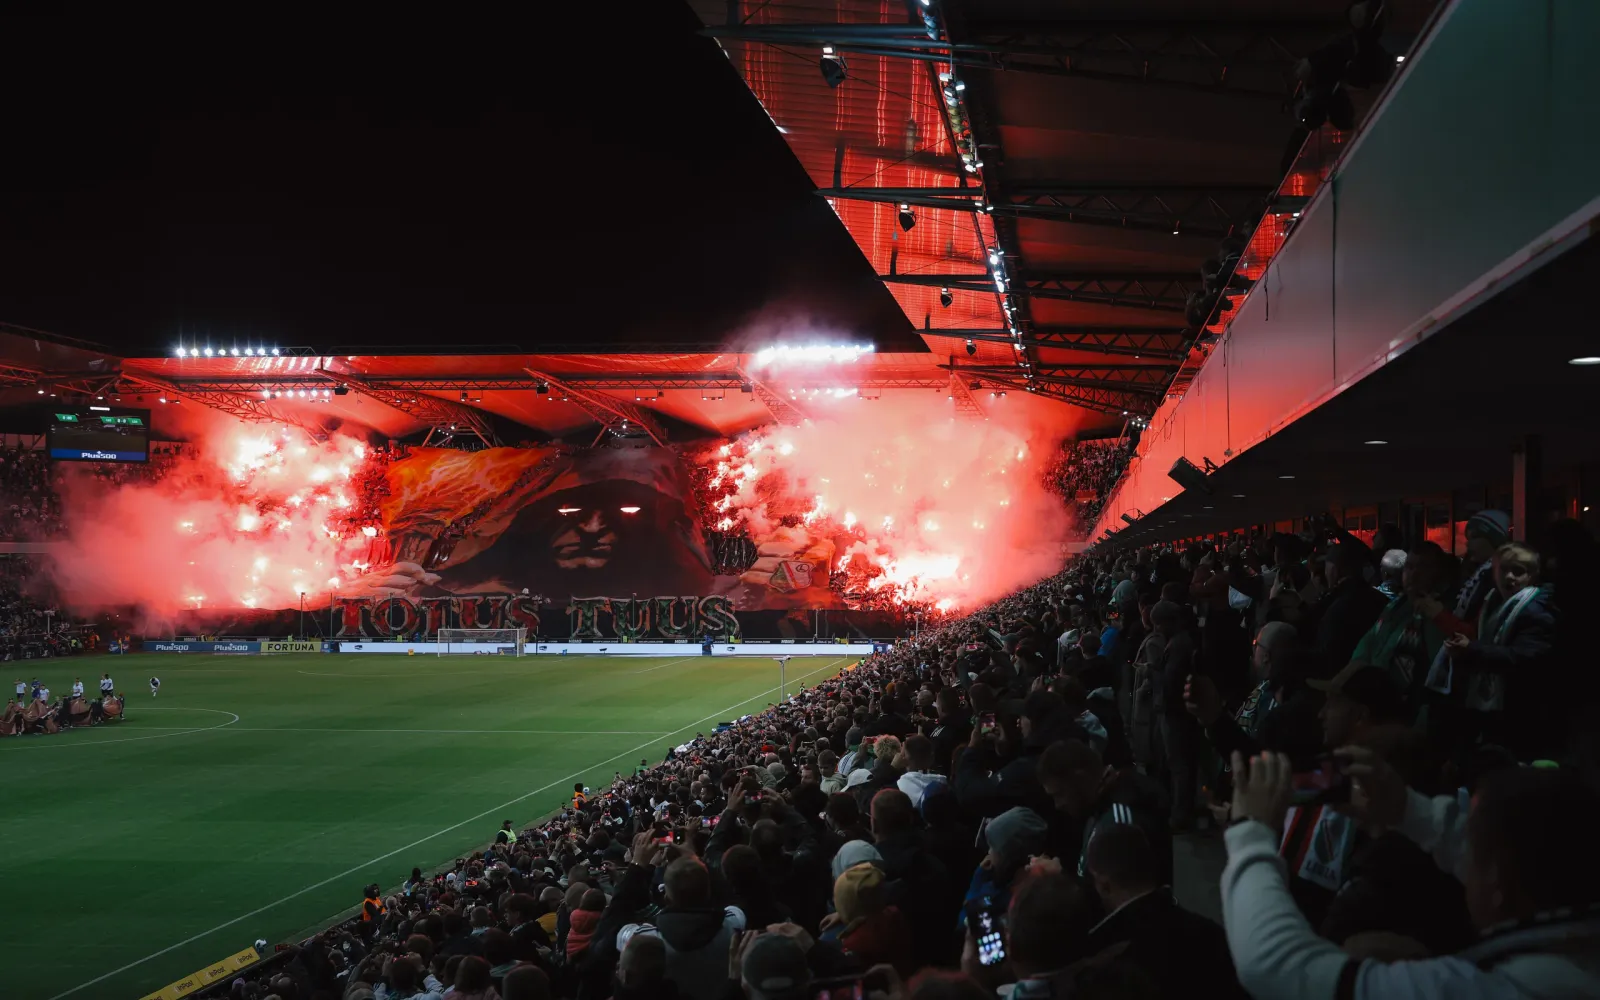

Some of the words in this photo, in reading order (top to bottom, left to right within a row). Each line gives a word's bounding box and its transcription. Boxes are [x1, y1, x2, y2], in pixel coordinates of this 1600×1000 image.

[81, 451, 117, 460] Plus500
[334, 595, 541, 639] TOTUS
[565, 595, 742, 639] TUUS
[156, 643, 189, 651] Plus500
[214, 643, 248, 651] Plus500
[267, 643, 315, 651] FORTUNA
[238, 953, 253, 964] InPost
[209, 966, 226, 978] InPost
[177, 980, 194, 992] InPost
